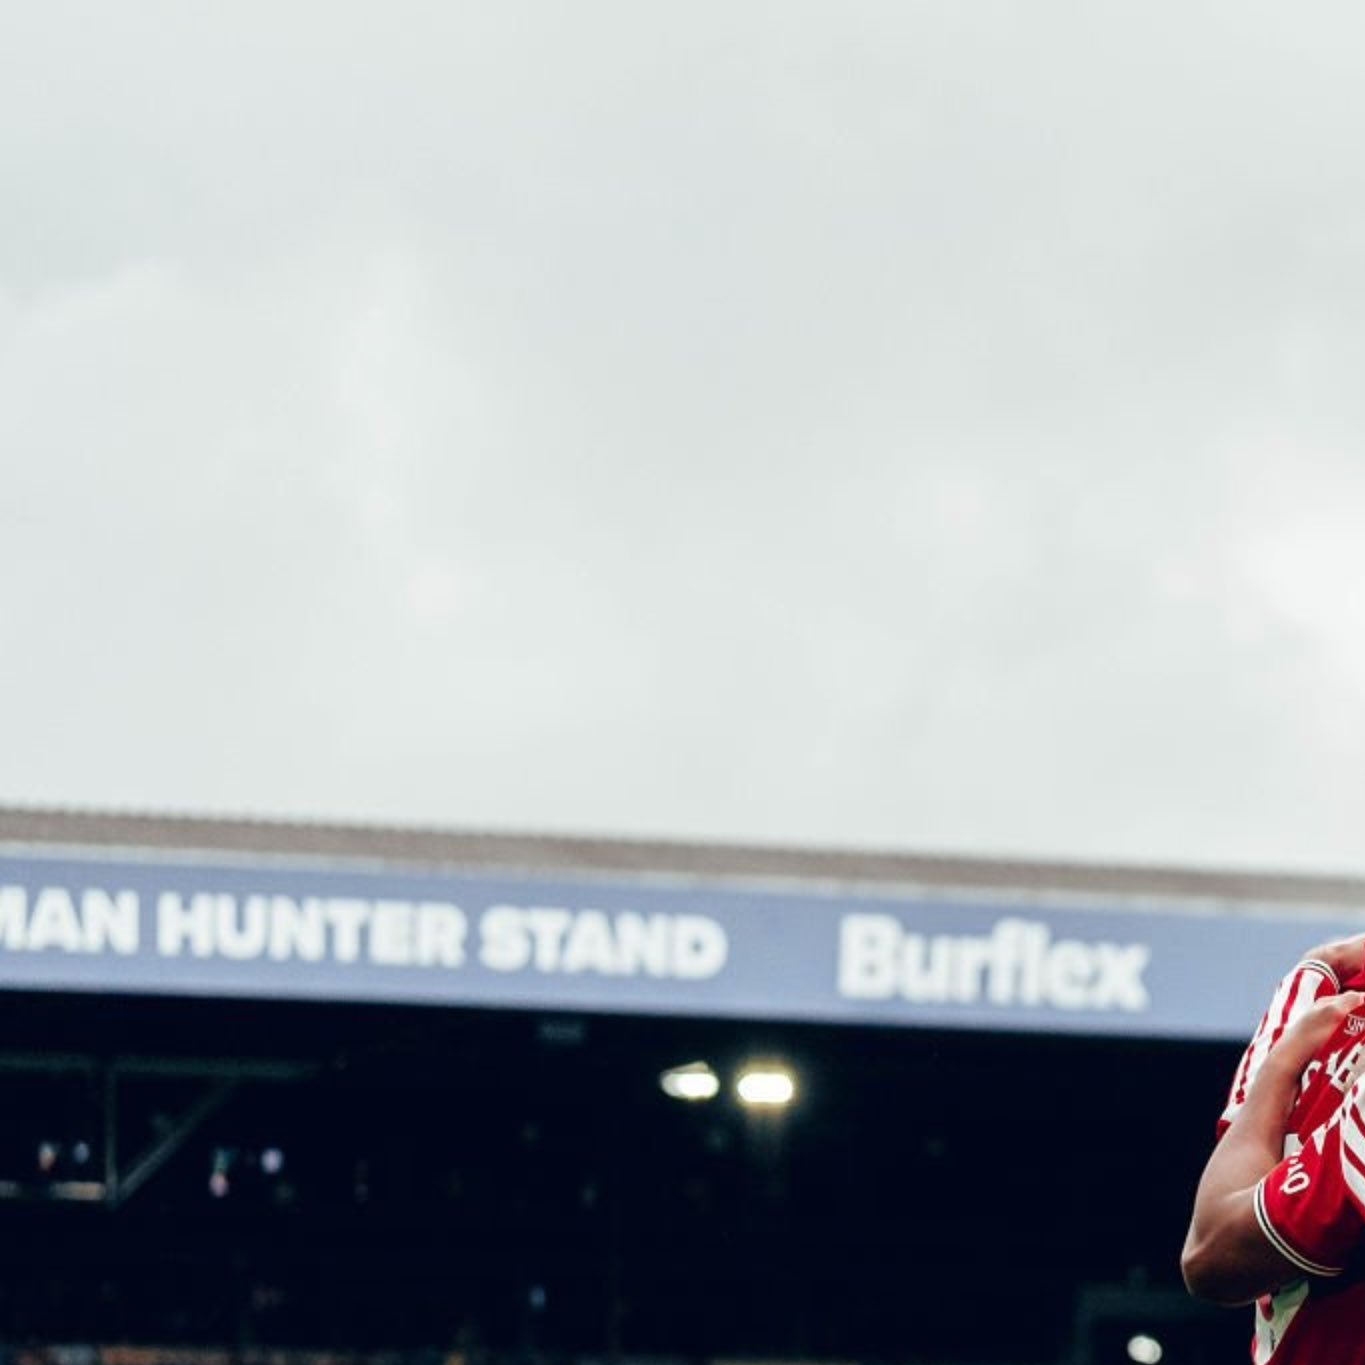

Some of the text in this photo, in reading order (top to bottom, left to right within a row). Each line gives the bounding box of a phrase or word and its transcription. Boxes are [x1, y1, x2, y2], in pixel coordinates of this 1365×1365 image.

[156, 890, 468, 968] HUNTER
[479, 908, 729, 980] STAND
[837, 913, 1151, 1013] Burflex
